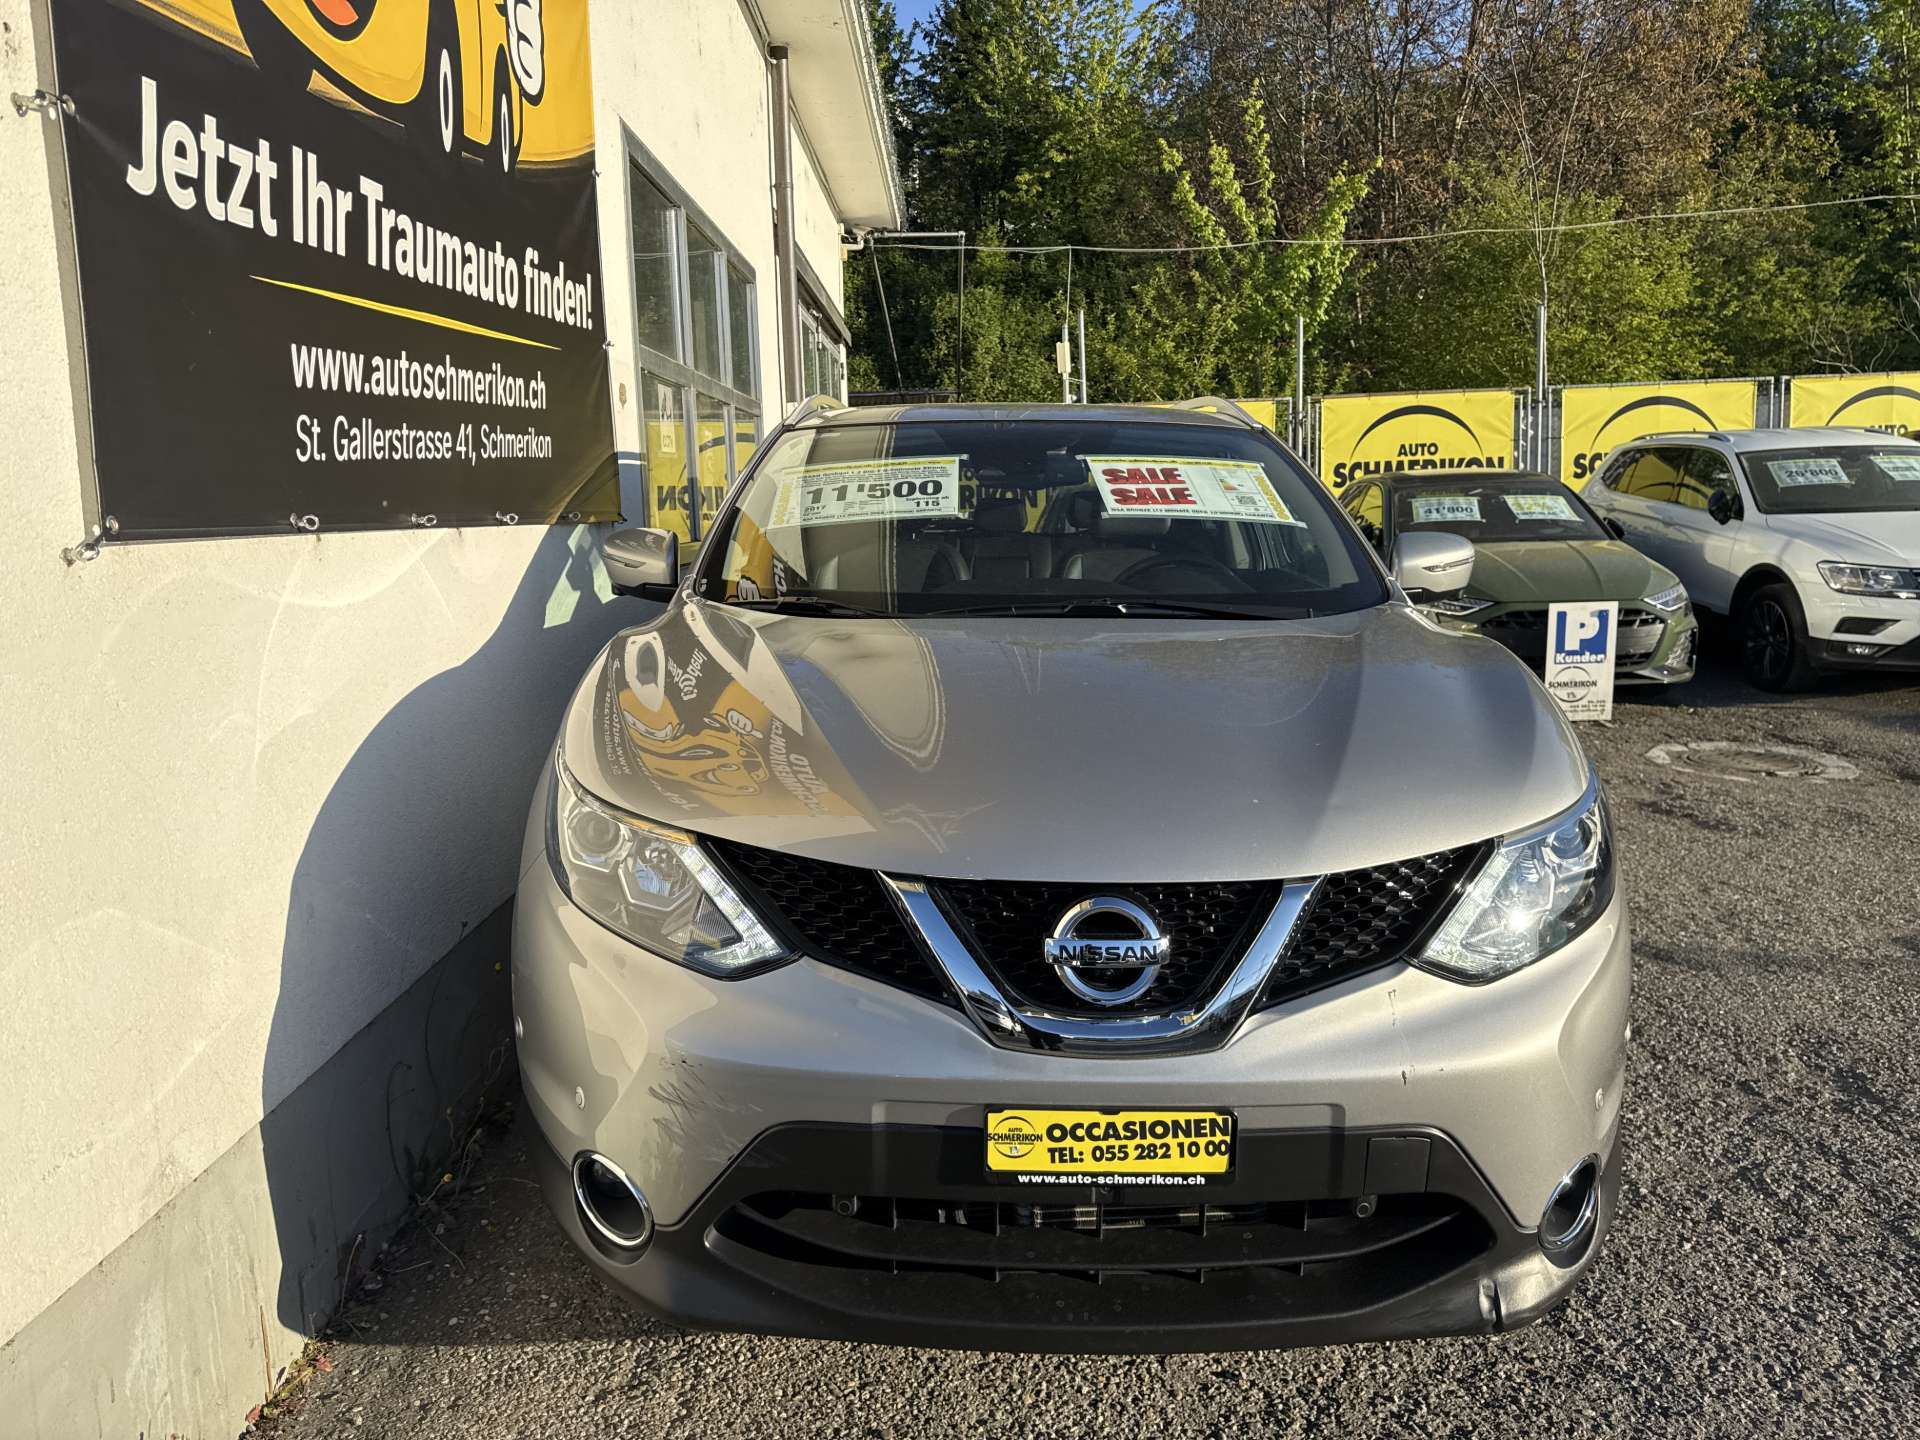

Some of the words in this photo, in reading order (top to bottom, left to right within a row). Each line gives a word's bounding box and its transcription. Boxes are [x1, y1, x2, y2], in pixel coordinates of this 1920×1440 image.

[126, 76, 277, 237] Jetzt
[292, 145, 352, 256] Ihr
[360, 175, 519, 308] Traumauto
[524, 248, 593, 330] finden!
[291, 343, 546, 410] www.autoschmerikon.ch
[296, 415, 326, 462] St.
[333, 416, 452, 461] Gallerstrasse
[456, 424, 476, 466] 41,
[480, 424, 552, 459] Schmerikon
[1397, 443, 1439, 457] AUTO
[1102, 467, 1186, 485] SALE
[806, 479, 943, 505] 11'500
[1110, 487, 1197, 505] SALE
[914, 500, 941, 508] 115
[1555, 651, 1606, 664] Kunden
[1060, 944, 1158, 962] NISSAN
[988, 1132, 1043, 1142] SCHMERIKON
[1046, 1117, 1230, 1143] OCCASIONEN
[1047, 1147, 1084, 1164] TEL:
[1091, 1145, 1129, 1162] 055
[1133, 1143, 1171, 1160] 282
[1177, 1141, 1200, 1158] 10
[1204, 1139, 1229, 1156] 00
[1017, 1174, 1206, 1185] www.auto-schmerikon.ch
